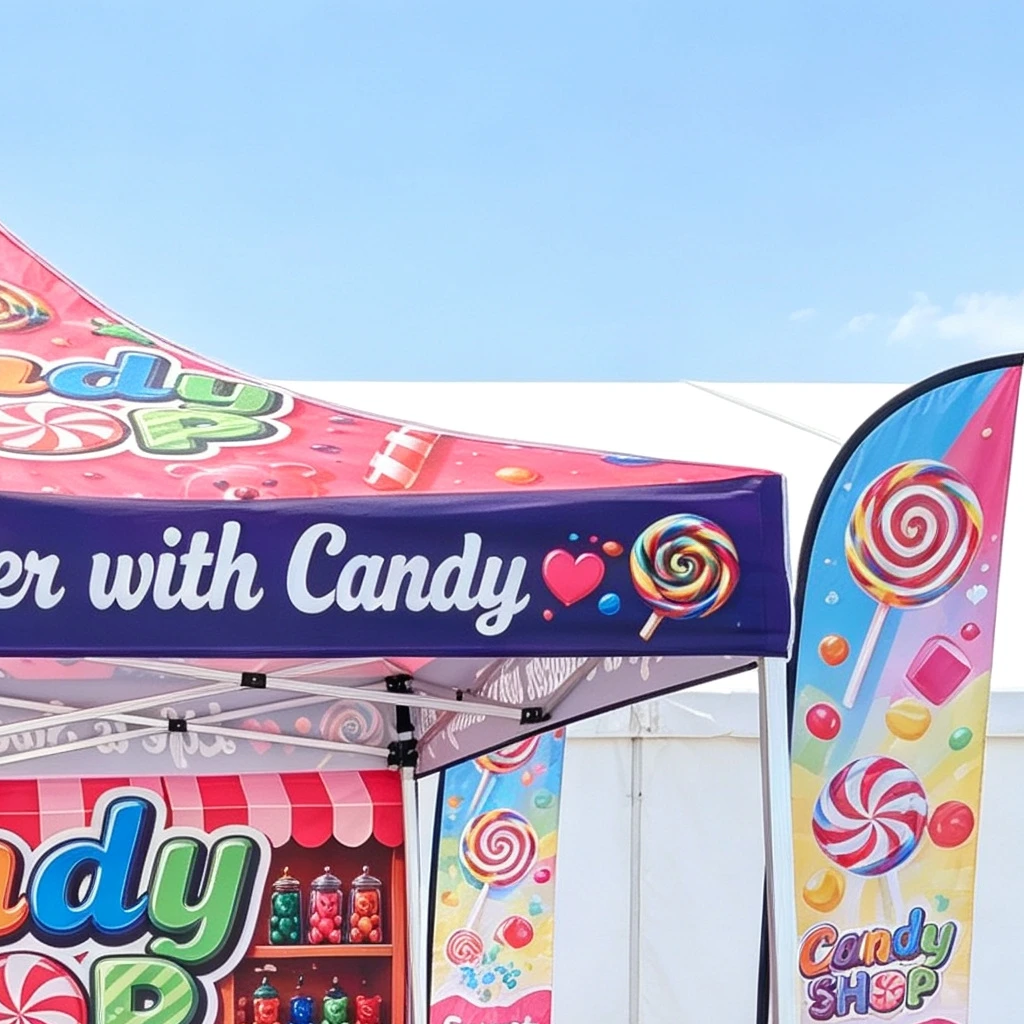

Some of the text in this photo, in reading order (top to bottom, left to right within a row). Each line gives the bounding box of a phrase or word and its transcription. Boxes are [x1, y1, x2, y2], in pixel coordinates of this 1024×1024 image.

[88, 520, 264, 611] with
[286, 522, 531, 637] Candy
[799, 907, 957, 978] Candy
[808, 965, 939, 1021] SHOP
